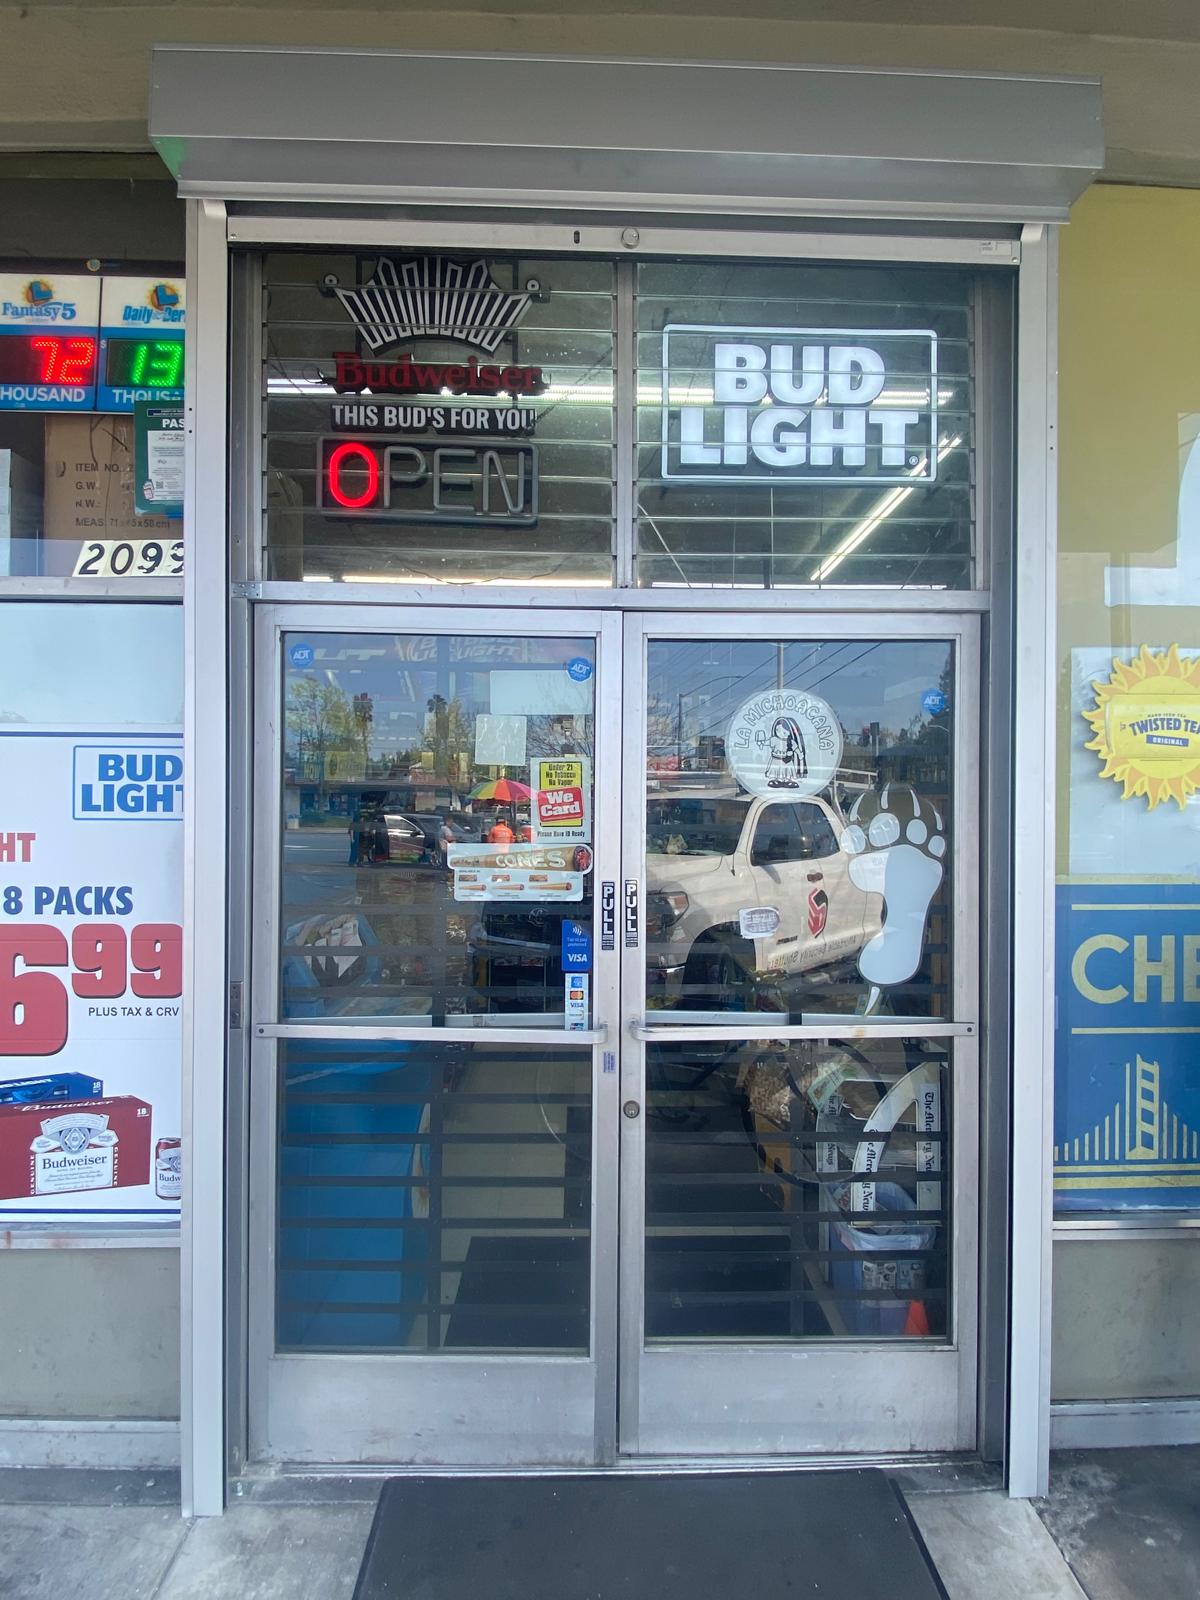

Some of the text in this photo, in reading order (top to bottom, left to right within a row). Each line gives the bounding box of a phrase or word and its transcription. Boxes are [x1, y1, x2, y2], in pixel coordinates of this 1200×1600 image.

[2, 302, 77, 321] Fantasy 5
[123, 305, 153, 324] Daily
[33, 340, 95, 383] 72
[132, 344, 182, 386] 13
[333, 352, 544, 391] Budweiser
[714, 343, 886, 405] BUD
[332, 404, 379, 426] THIS
[384, 406, 446, 428] BUD'S
[450, 408, 491, 430] FOR
[680, 406, 919, 467] LIGHT
[76, 463, 98, 472] ITEM
[329, 442, 525, 513] OPEN
[293, 649, 311, 660] ADT
[572, 663, 590, 674] ADT
[923, 695, 942, 705] ADT
[734, 694, 835, 752] LA MICHOACANA
[1129, 717, 1182, 737] TWISTED
[1152, 737, 1184, 746] ORIGINAL
[98, 754, 183, 782] BUD
[546, 790, 574, 804] We
[540, 801, 581, 817] Card
[495, 850, 566, 868] CONES
[34, 885, 134, 916] PACKS
[626, 884, 637, 932] PULL
[602, 886, 614, 935] PULL
[567, 953, 588, 962] VISA
[88, 1006, 180, 1017] PLUS TAX & CRV
[923, 1092, 935, 1110] The
[42, 1155, 108, 1170] Budweiser
